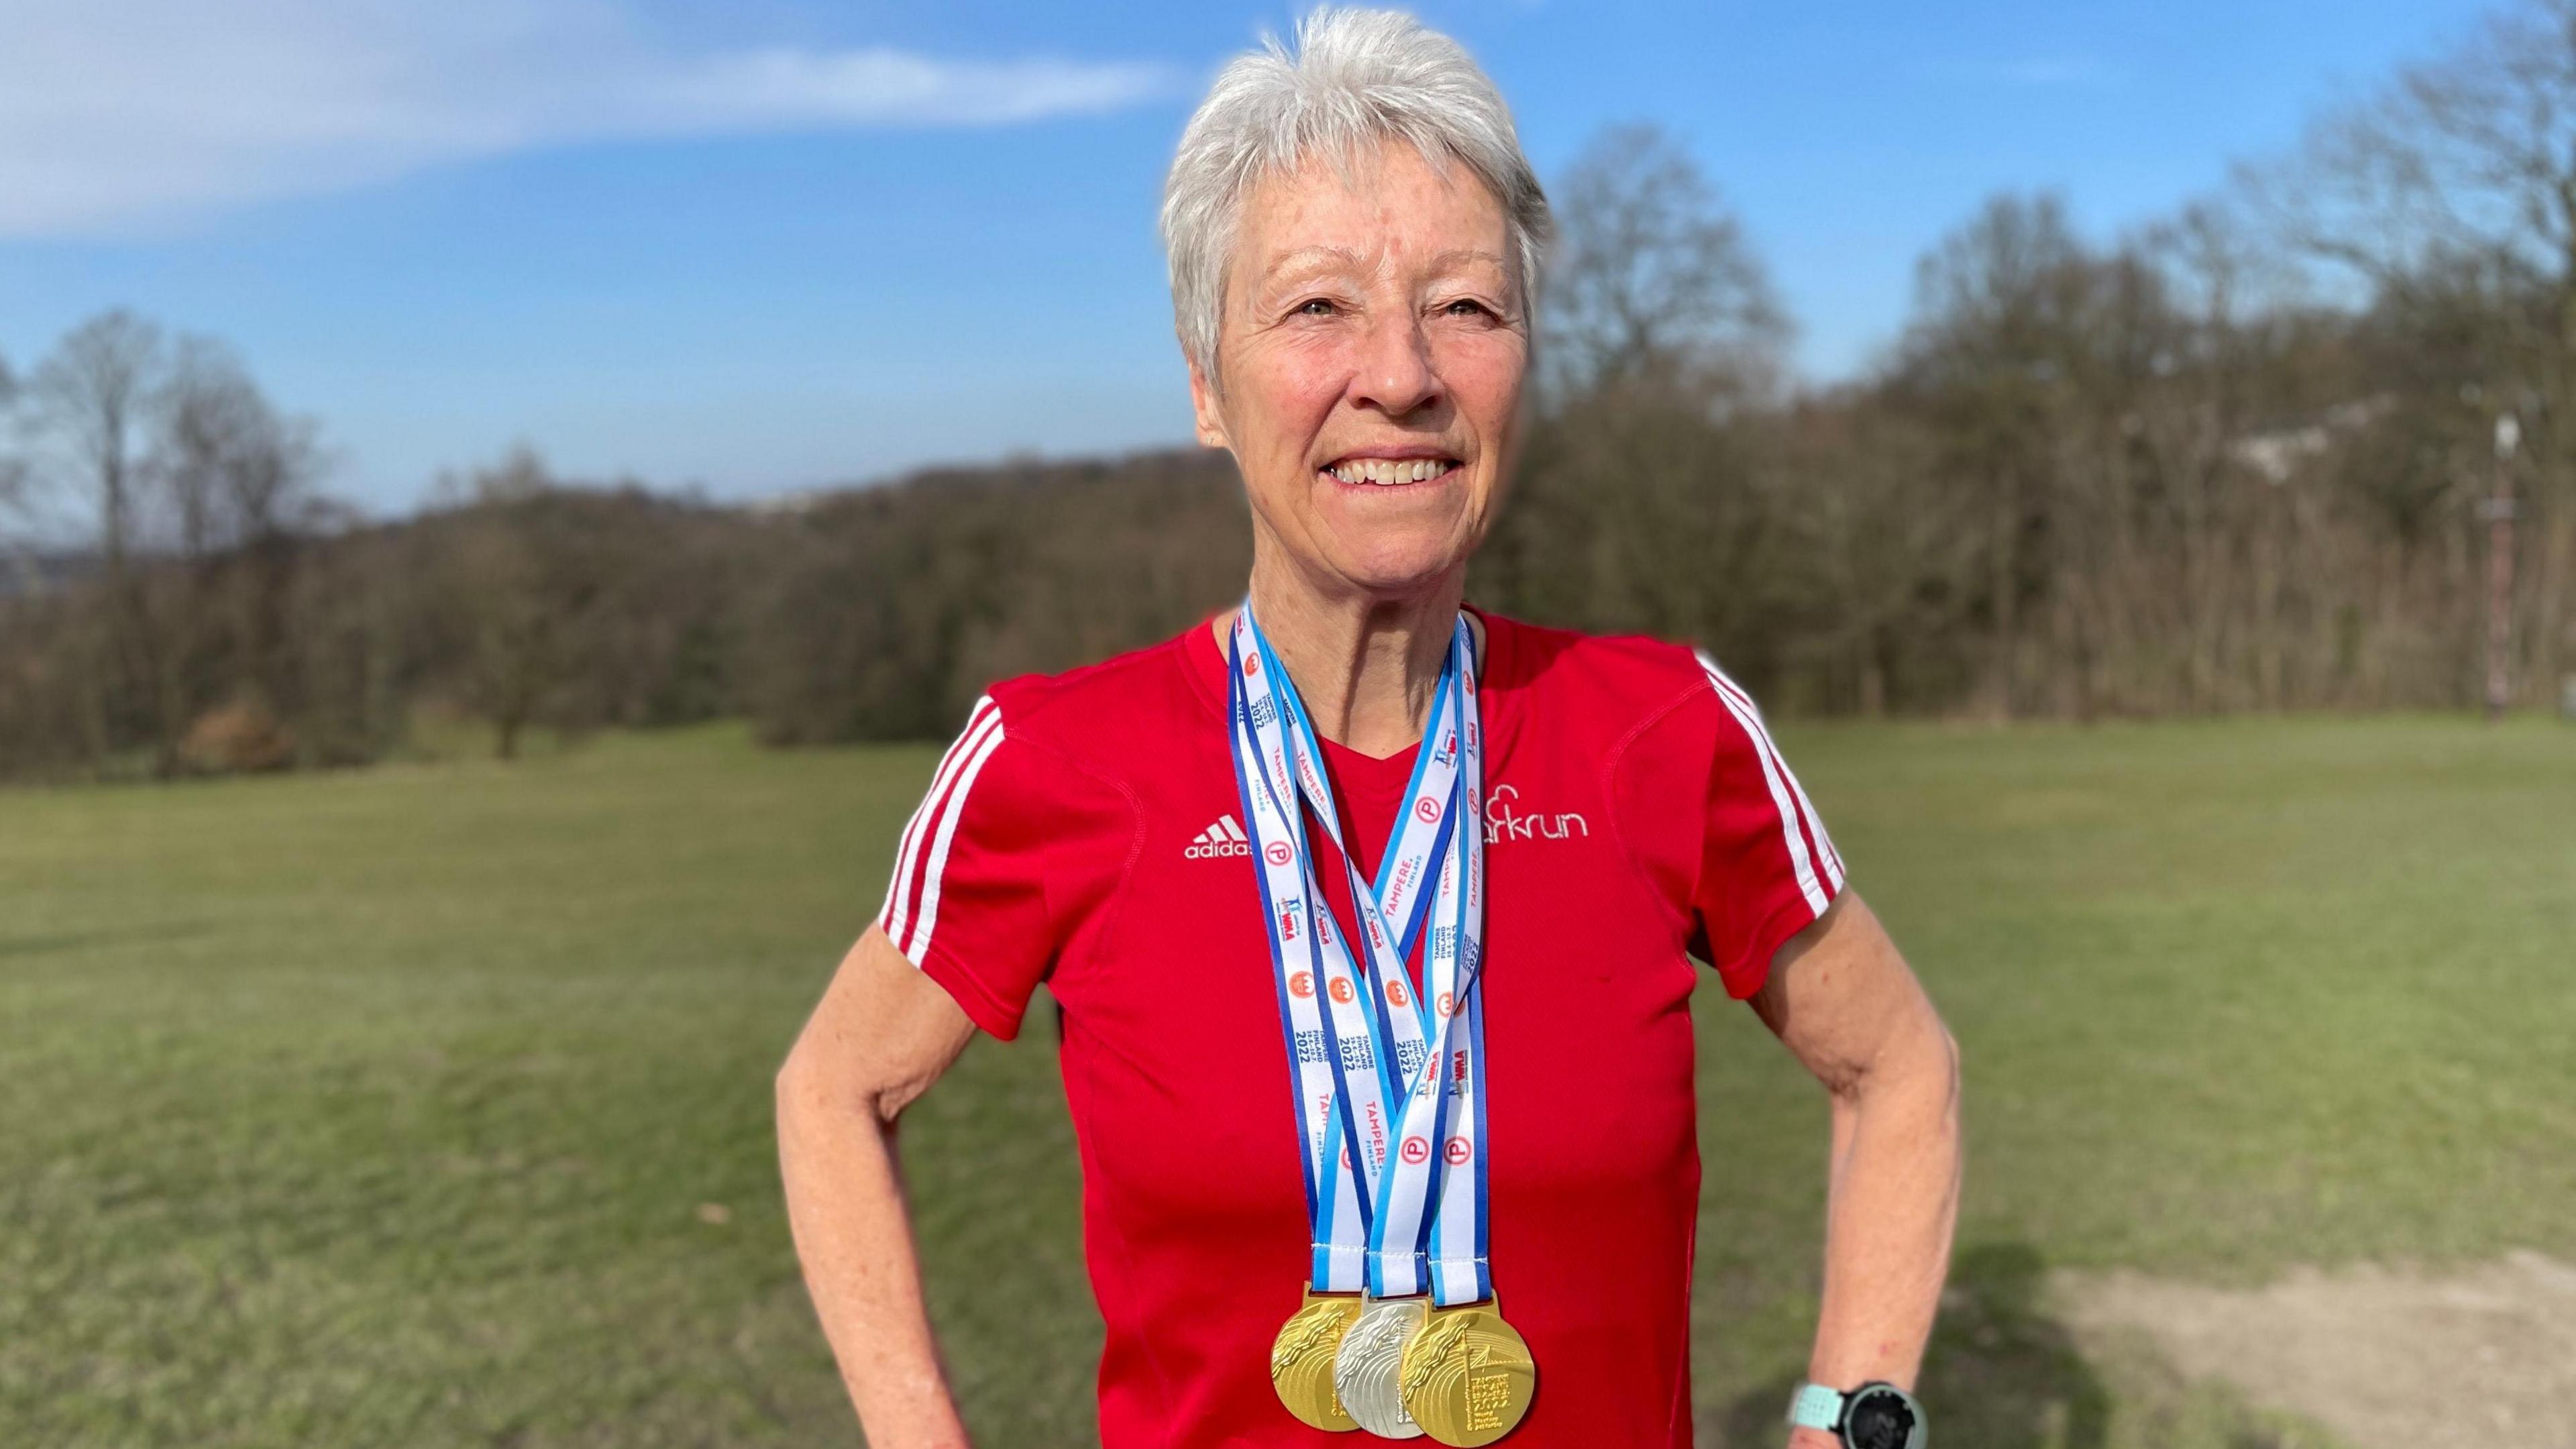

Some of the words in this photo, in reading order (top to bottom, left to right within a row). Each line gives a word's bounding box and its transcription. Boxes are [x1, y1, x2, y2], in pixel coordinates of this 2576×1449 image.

[1250, 702, 1265, 730] 2022
[1254, 779, 1266, 812] FINLAND
[1483, 804, 1589, 844] rkrun
[1407, 855, 1422, 888] FINLAND
[1281, 912, 1296, 941] WMA
[1467, 942, 1479, 975] 2022
[1295, 1031, 1310, 1063] 2022
[1313, 1030, 1323, 1063] FINLAND
[1339, 1037, 1355, 1071] 2022
[1356, 1036, 1368, 1070] FINLAND
[1362, 1034, 1375, 1069] TAMPERE
[1397, 1041, 1413, 1075] 2022
[1411, 1039, 1424, 1068] FINLAN
[1428, 1051, 1440, 1081] WMA
[1454, 1050, 1465, 1081] WMA
[1366, 1140, 1378, 1177] FINLAND
